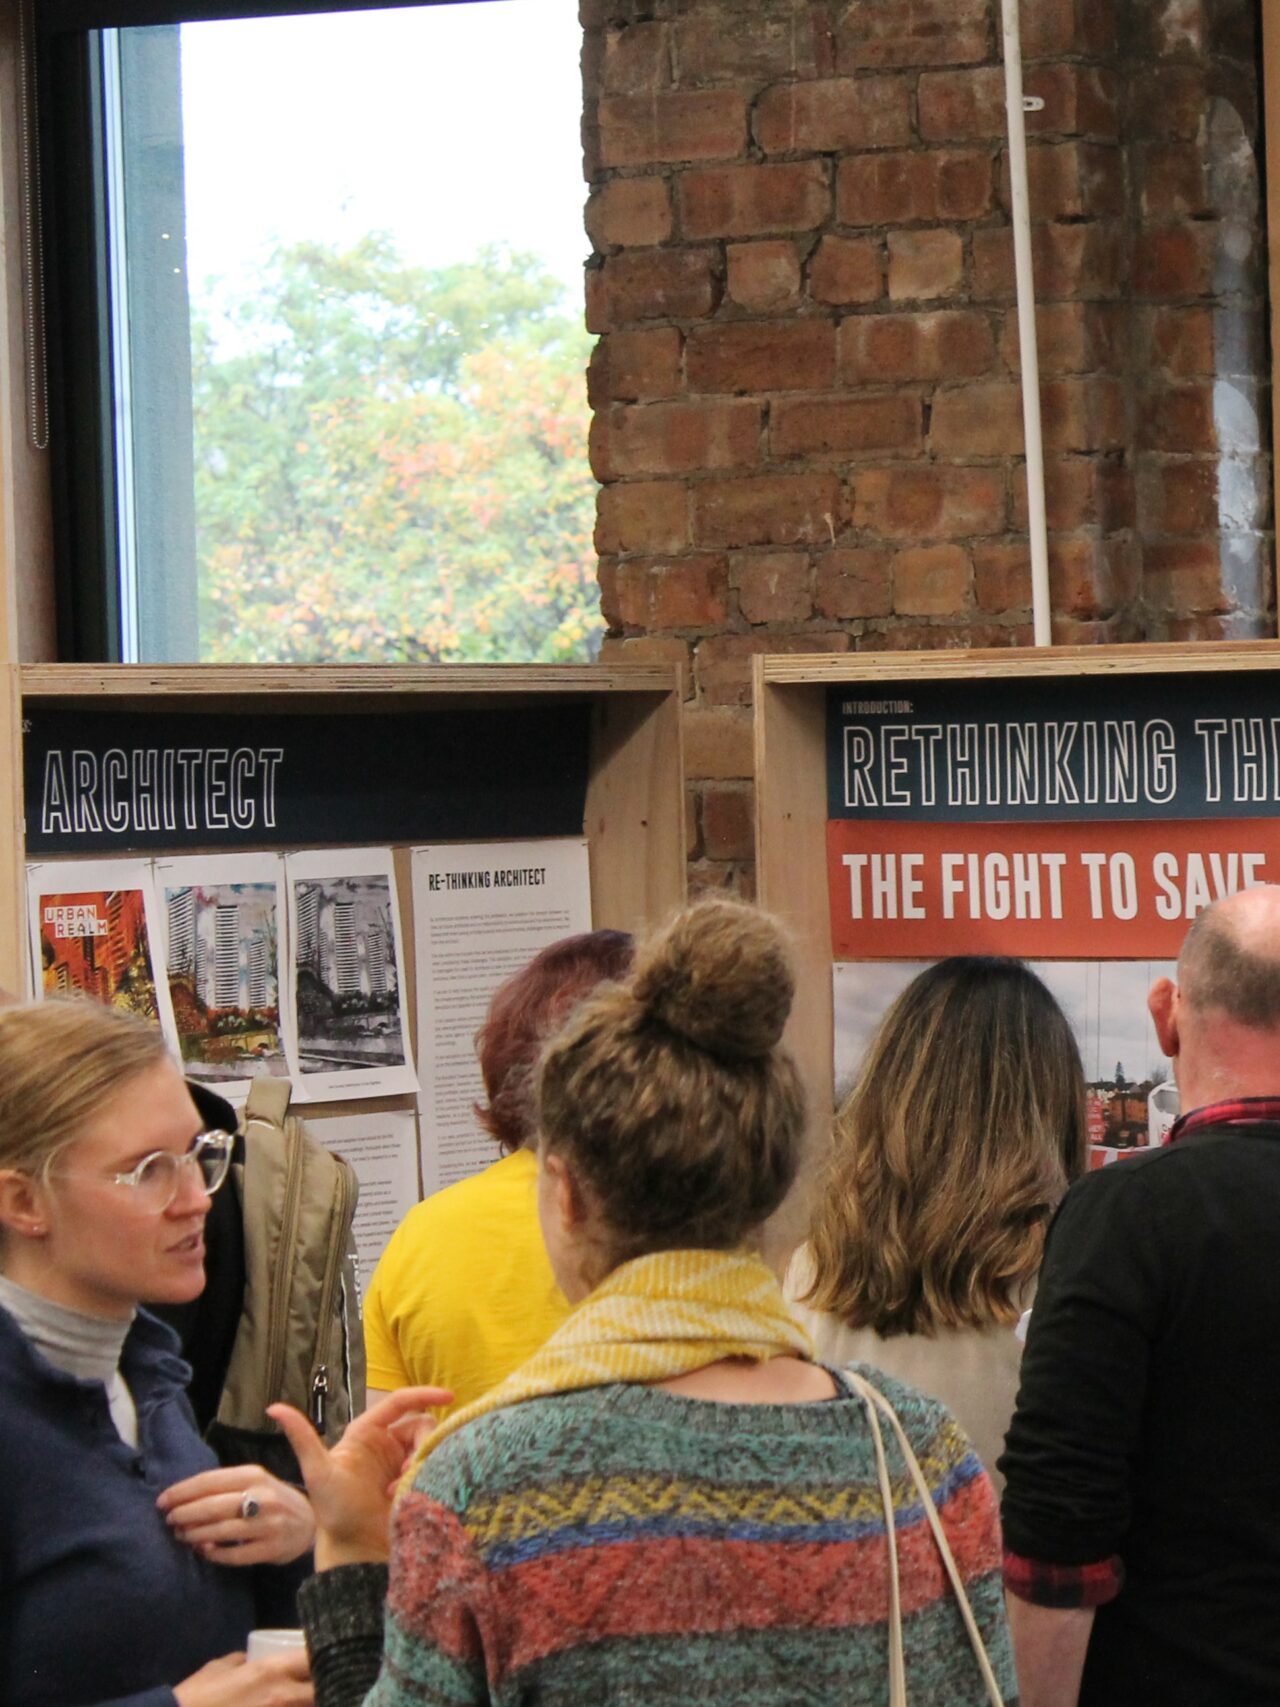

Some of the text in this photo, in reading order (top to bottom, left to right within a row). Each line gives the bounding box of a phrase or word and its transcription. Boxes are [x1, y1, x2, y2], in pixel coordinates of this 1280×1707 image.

[842, 700, 914, 715] INTRODUCTION:
[842, 718, 1177, 807] RETHINKING
[42, 747, 284, 833] ARCHITECT
[429, 868, 546, 891] RE-THINKING ARCHITECT
[842, 852, 926, 920] THE
[941, 851, 1067, 921] FIGHT
[1081, 851, 1138, 920] TO
[46, 906, 96, 921] URBAN
[57, 922, 107, 936] REALM
